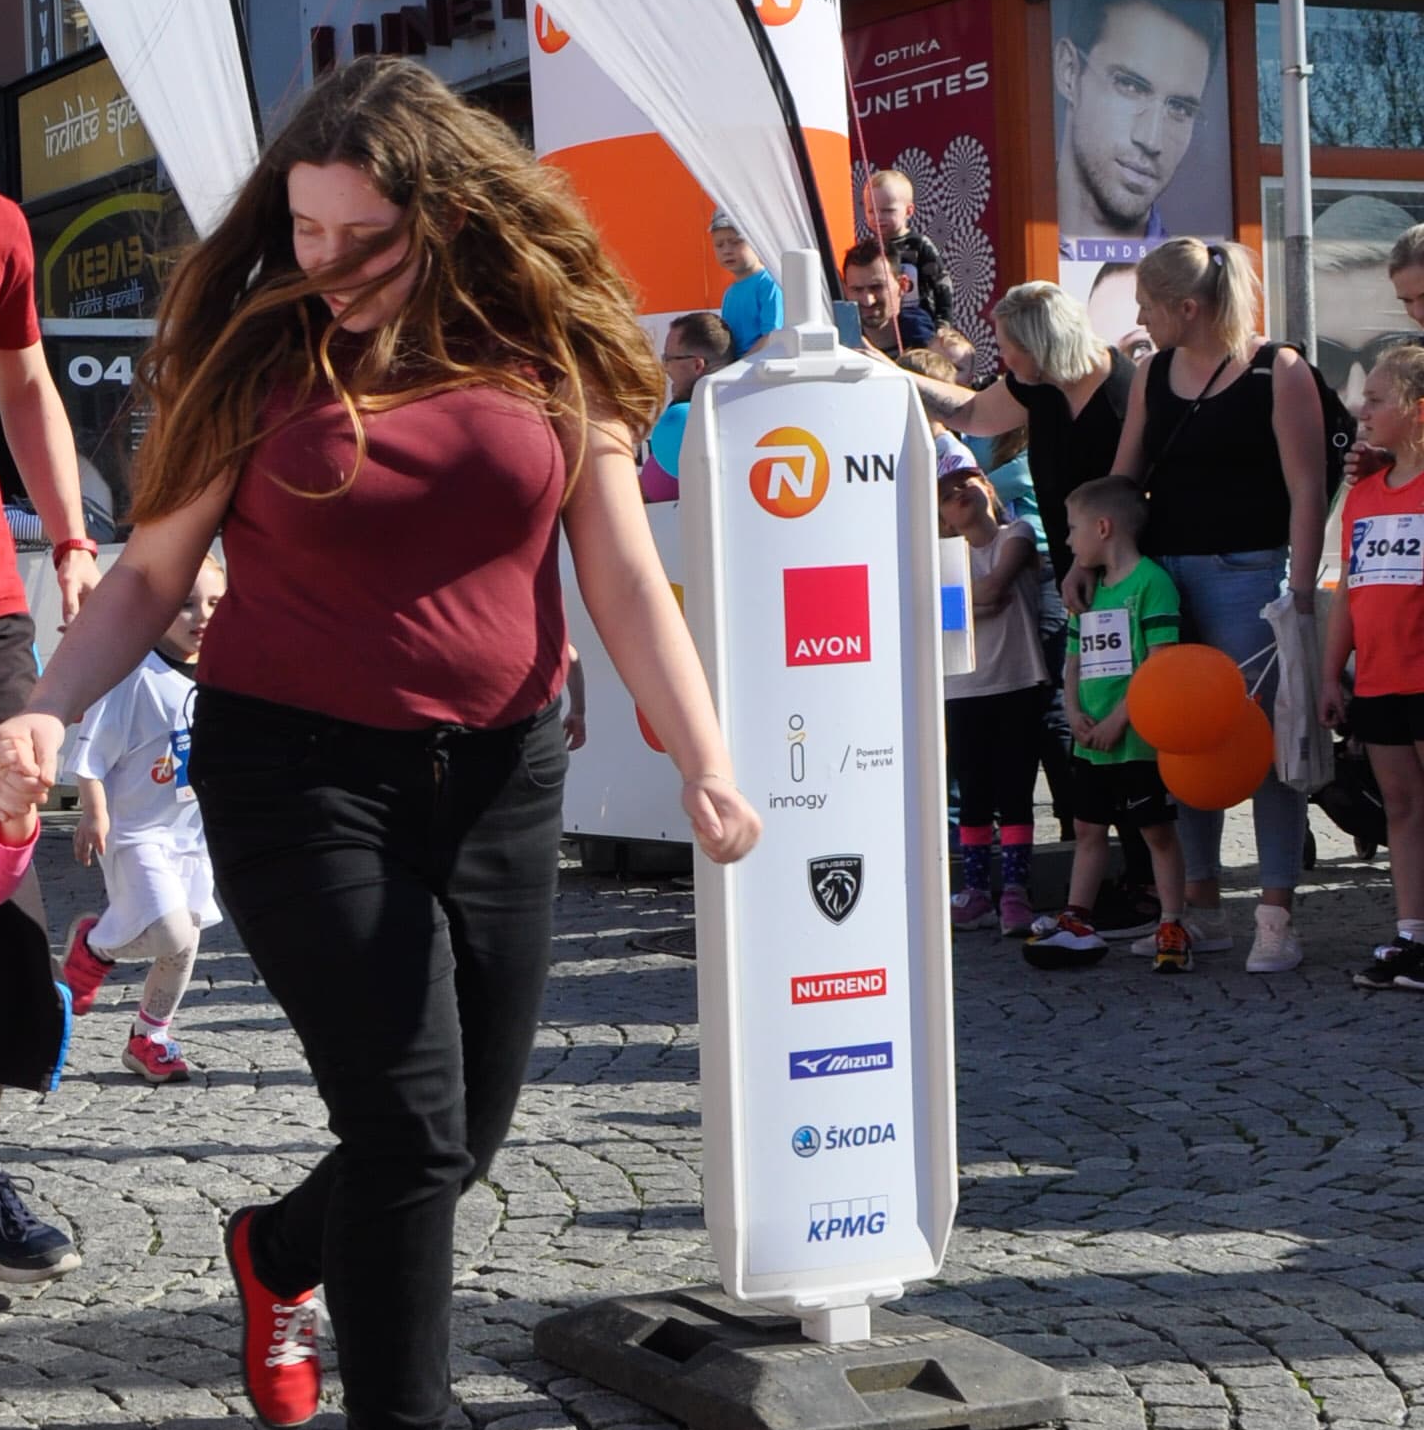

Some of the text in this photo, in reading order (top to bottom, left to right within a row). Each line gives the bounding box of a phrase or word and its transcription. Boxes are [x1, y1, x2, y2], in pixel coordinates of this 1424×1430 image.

[874, 39, 941, 67] OPTIKA
[857, 61, 990, 119] UNETTES
[1079, 244, 1147, 259] LINDB
[845, 454, 895, 483] NN
[1366, 538, 1421, 558] 3042
[795, 635, 862, 658] AVON
[856, 746, 894, 758] Powered
[768, 791, 827, 809] innogy
[811, 859, 860, 870] PEUGEOT
[796, 975, 883, 999] NUTREND
[825, 1122, 896, 1150] ŠKODA
[807, 1212, 887, 1243] KPMG
